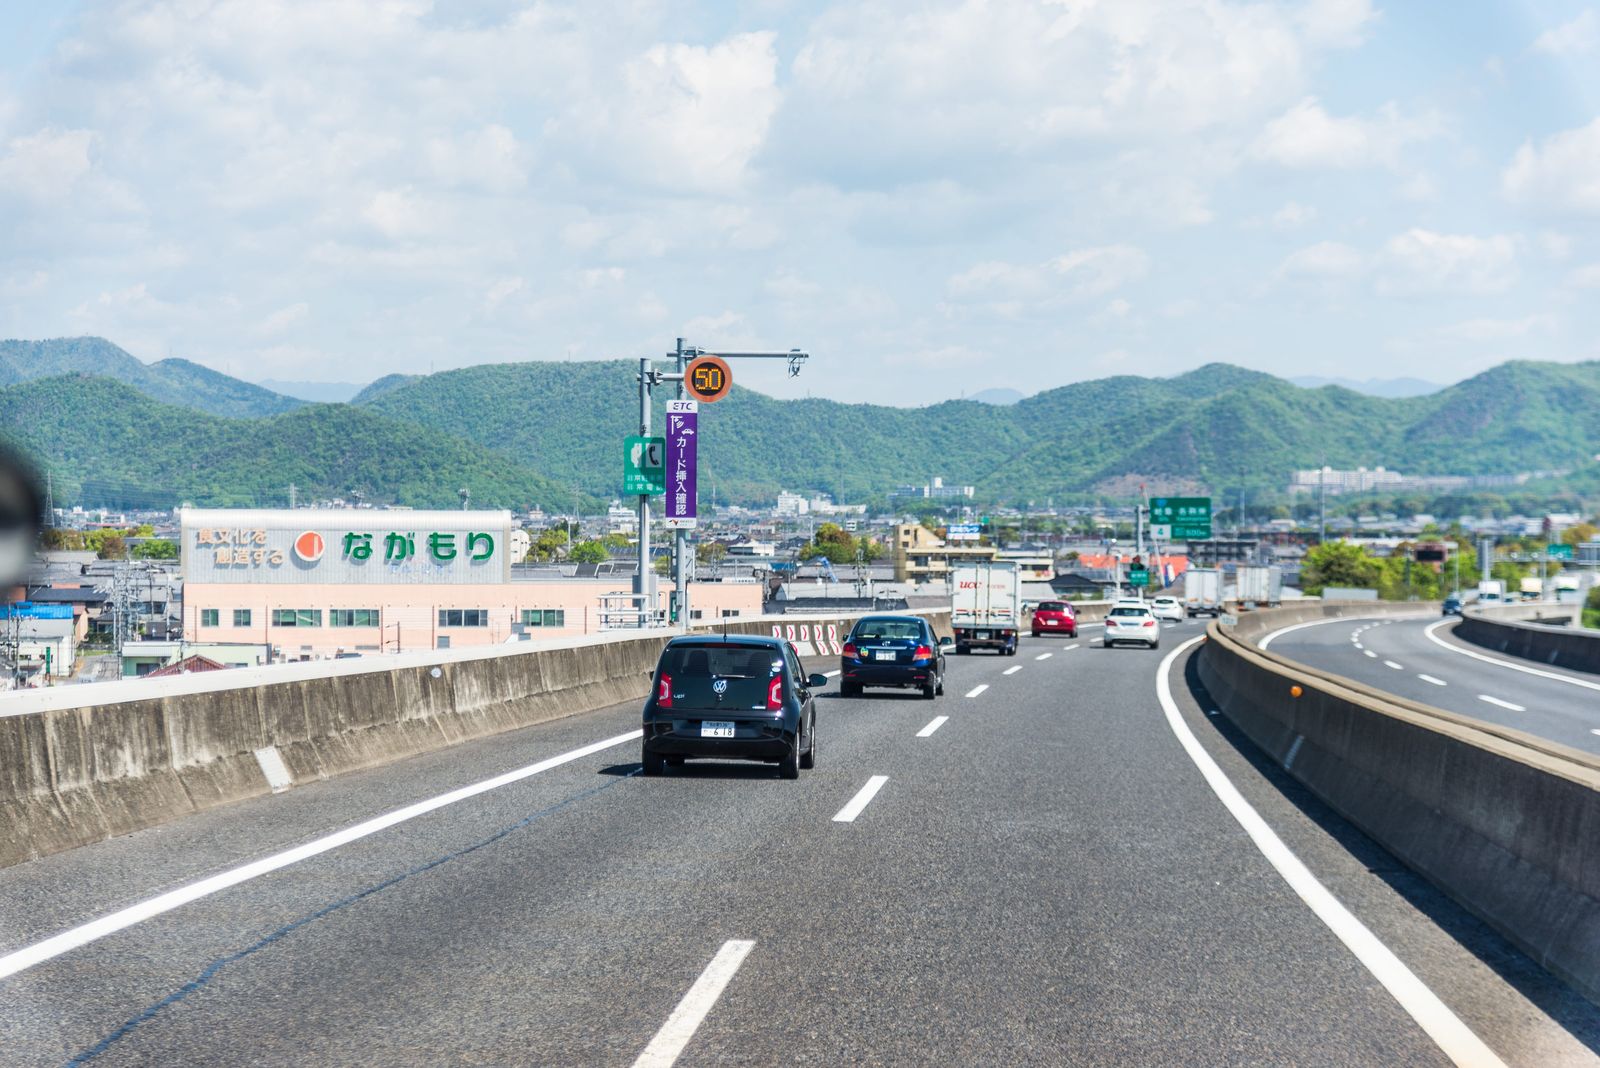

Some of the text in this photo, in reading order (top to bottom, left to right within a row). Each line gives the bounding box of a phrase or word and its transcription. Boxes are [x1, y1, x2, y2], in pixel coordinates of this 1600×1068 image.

[695, 368, 722, 391] 50
[673, 402, 693, 411] ETC
[675, 437, 687, 516] カード挿入確認
[197, 528, 266, 544] 食文化を
[344, 531, 495, 561] ながもり
